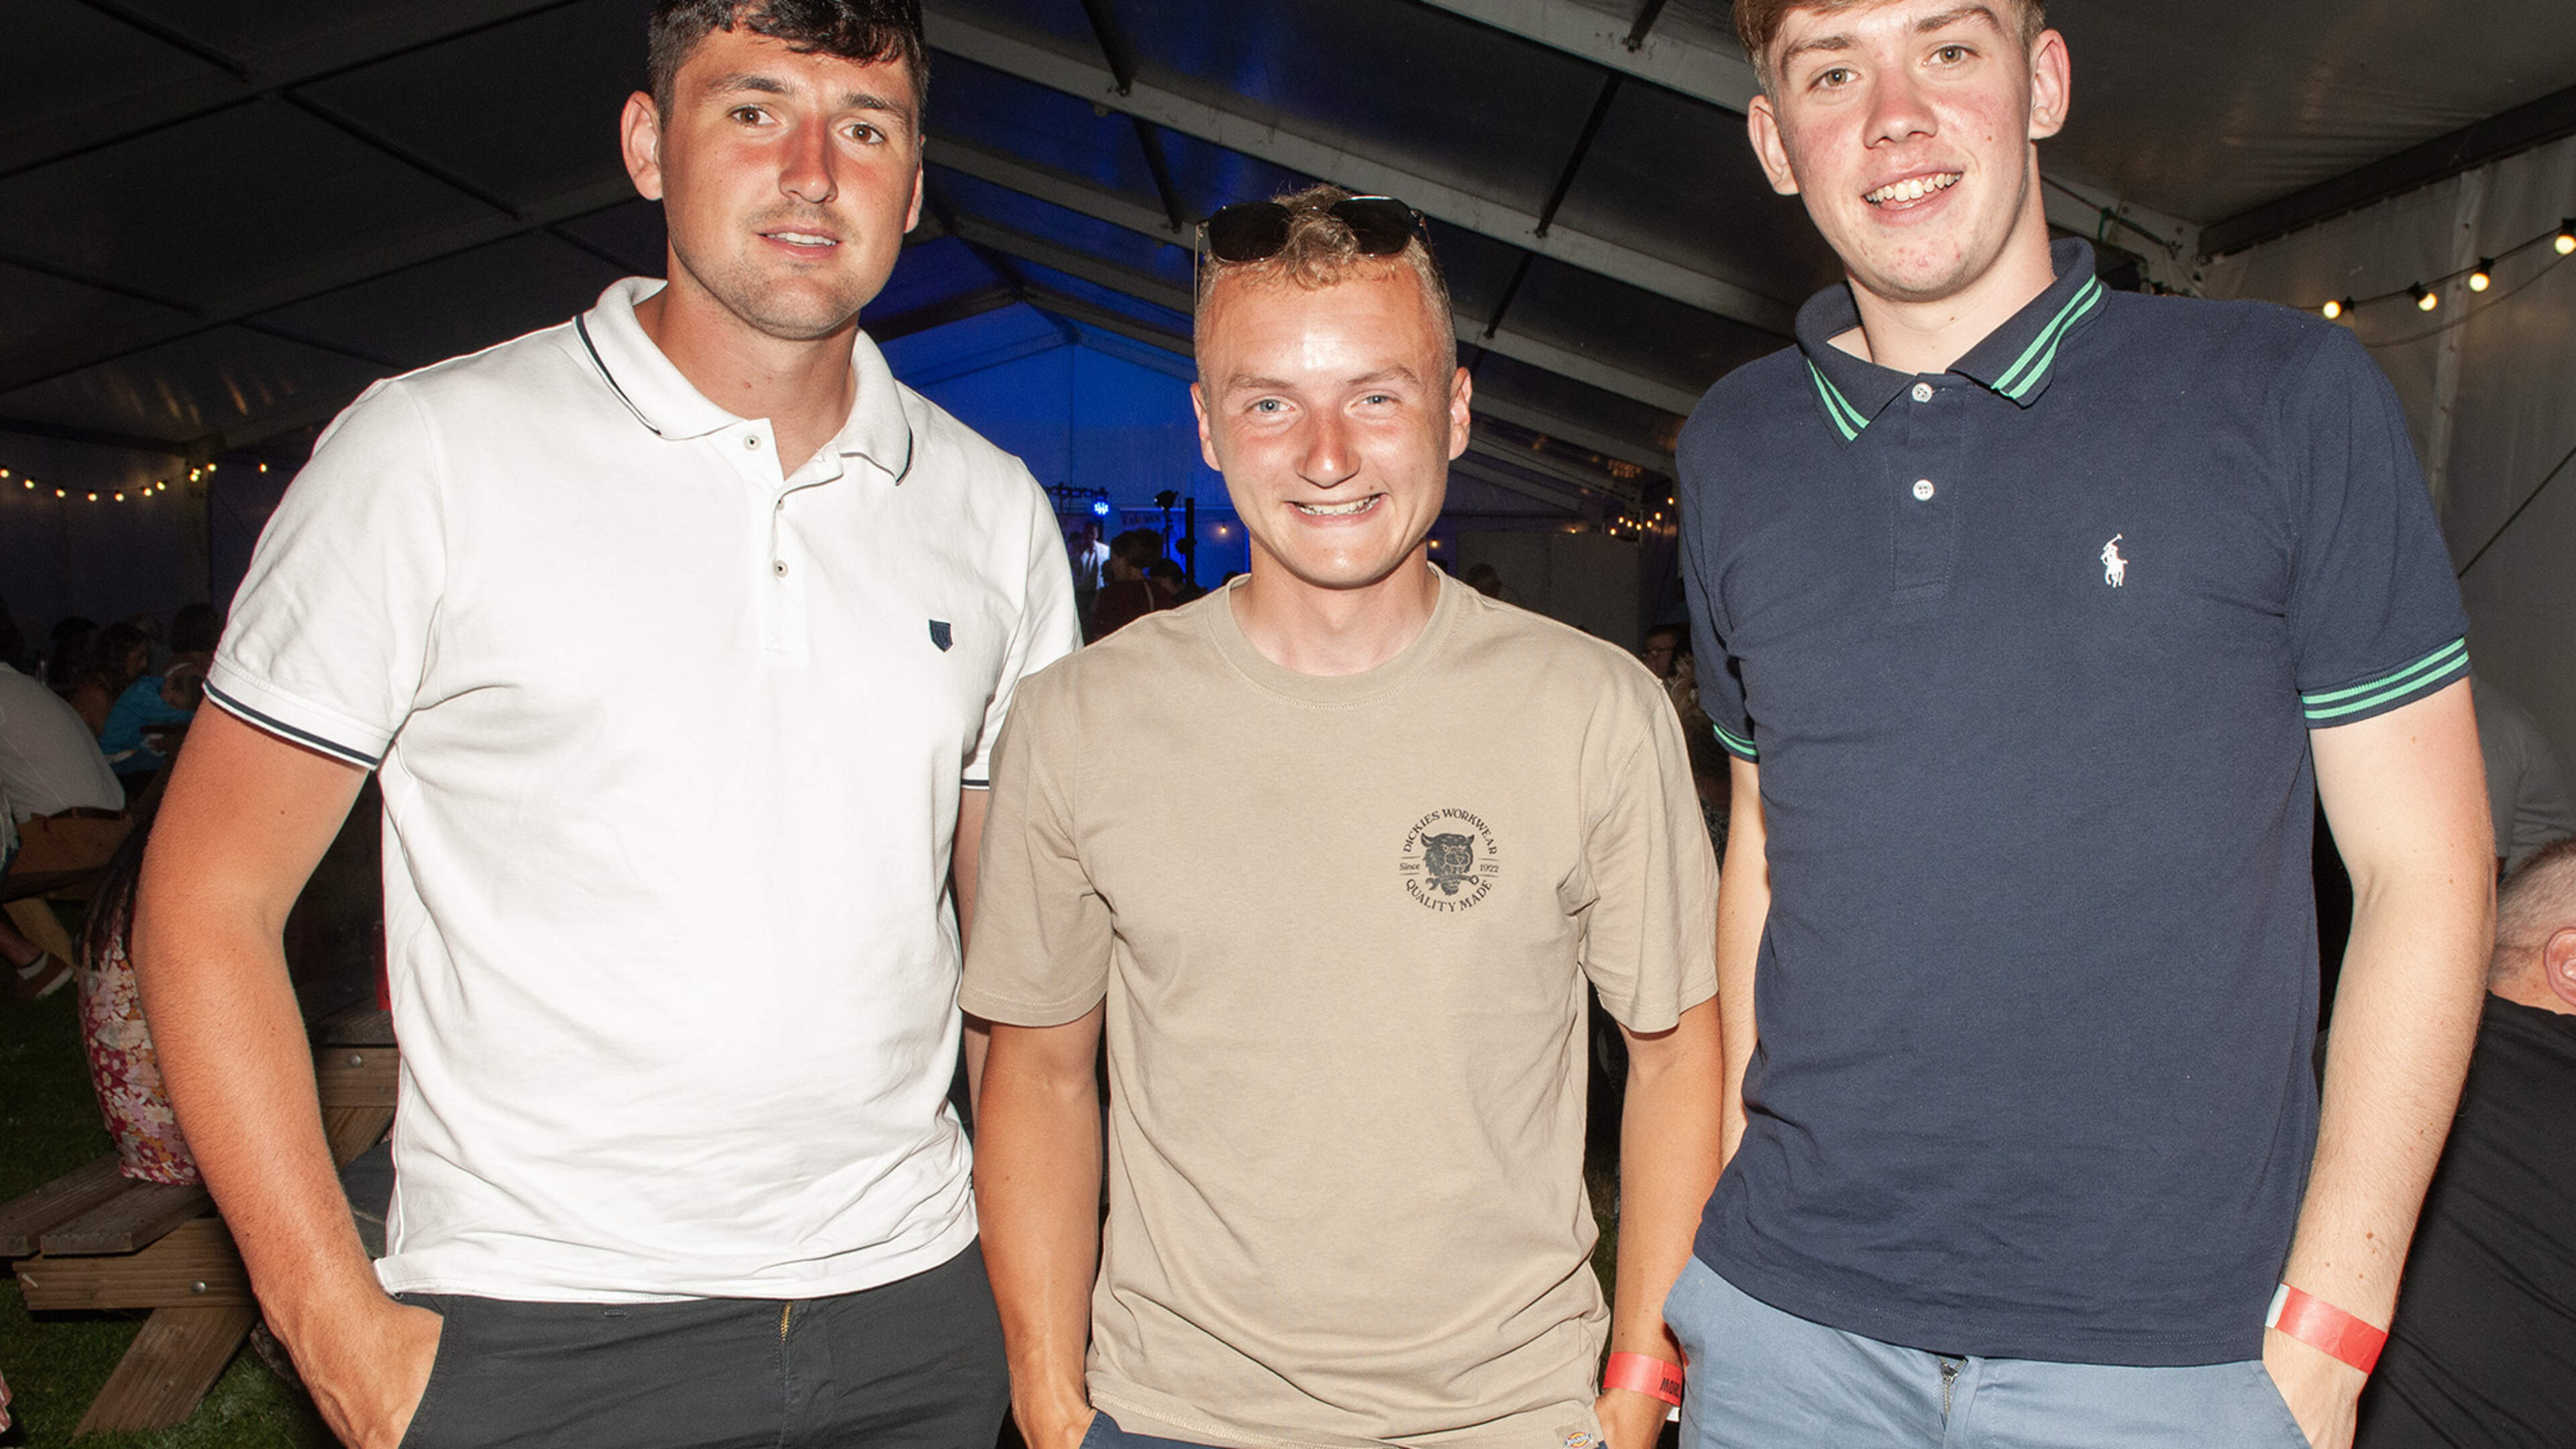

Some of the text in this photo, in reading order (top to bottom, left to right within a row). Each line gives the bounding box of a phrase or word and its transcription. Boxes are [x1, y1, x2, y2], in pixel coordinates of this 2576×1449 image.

[1403, 808, 1498, 855] DICKIES WORKWEAR
[1399, 862, 1499, 872] Since 1922
[1405, 878, 1493, 912] QUALITY MADE
